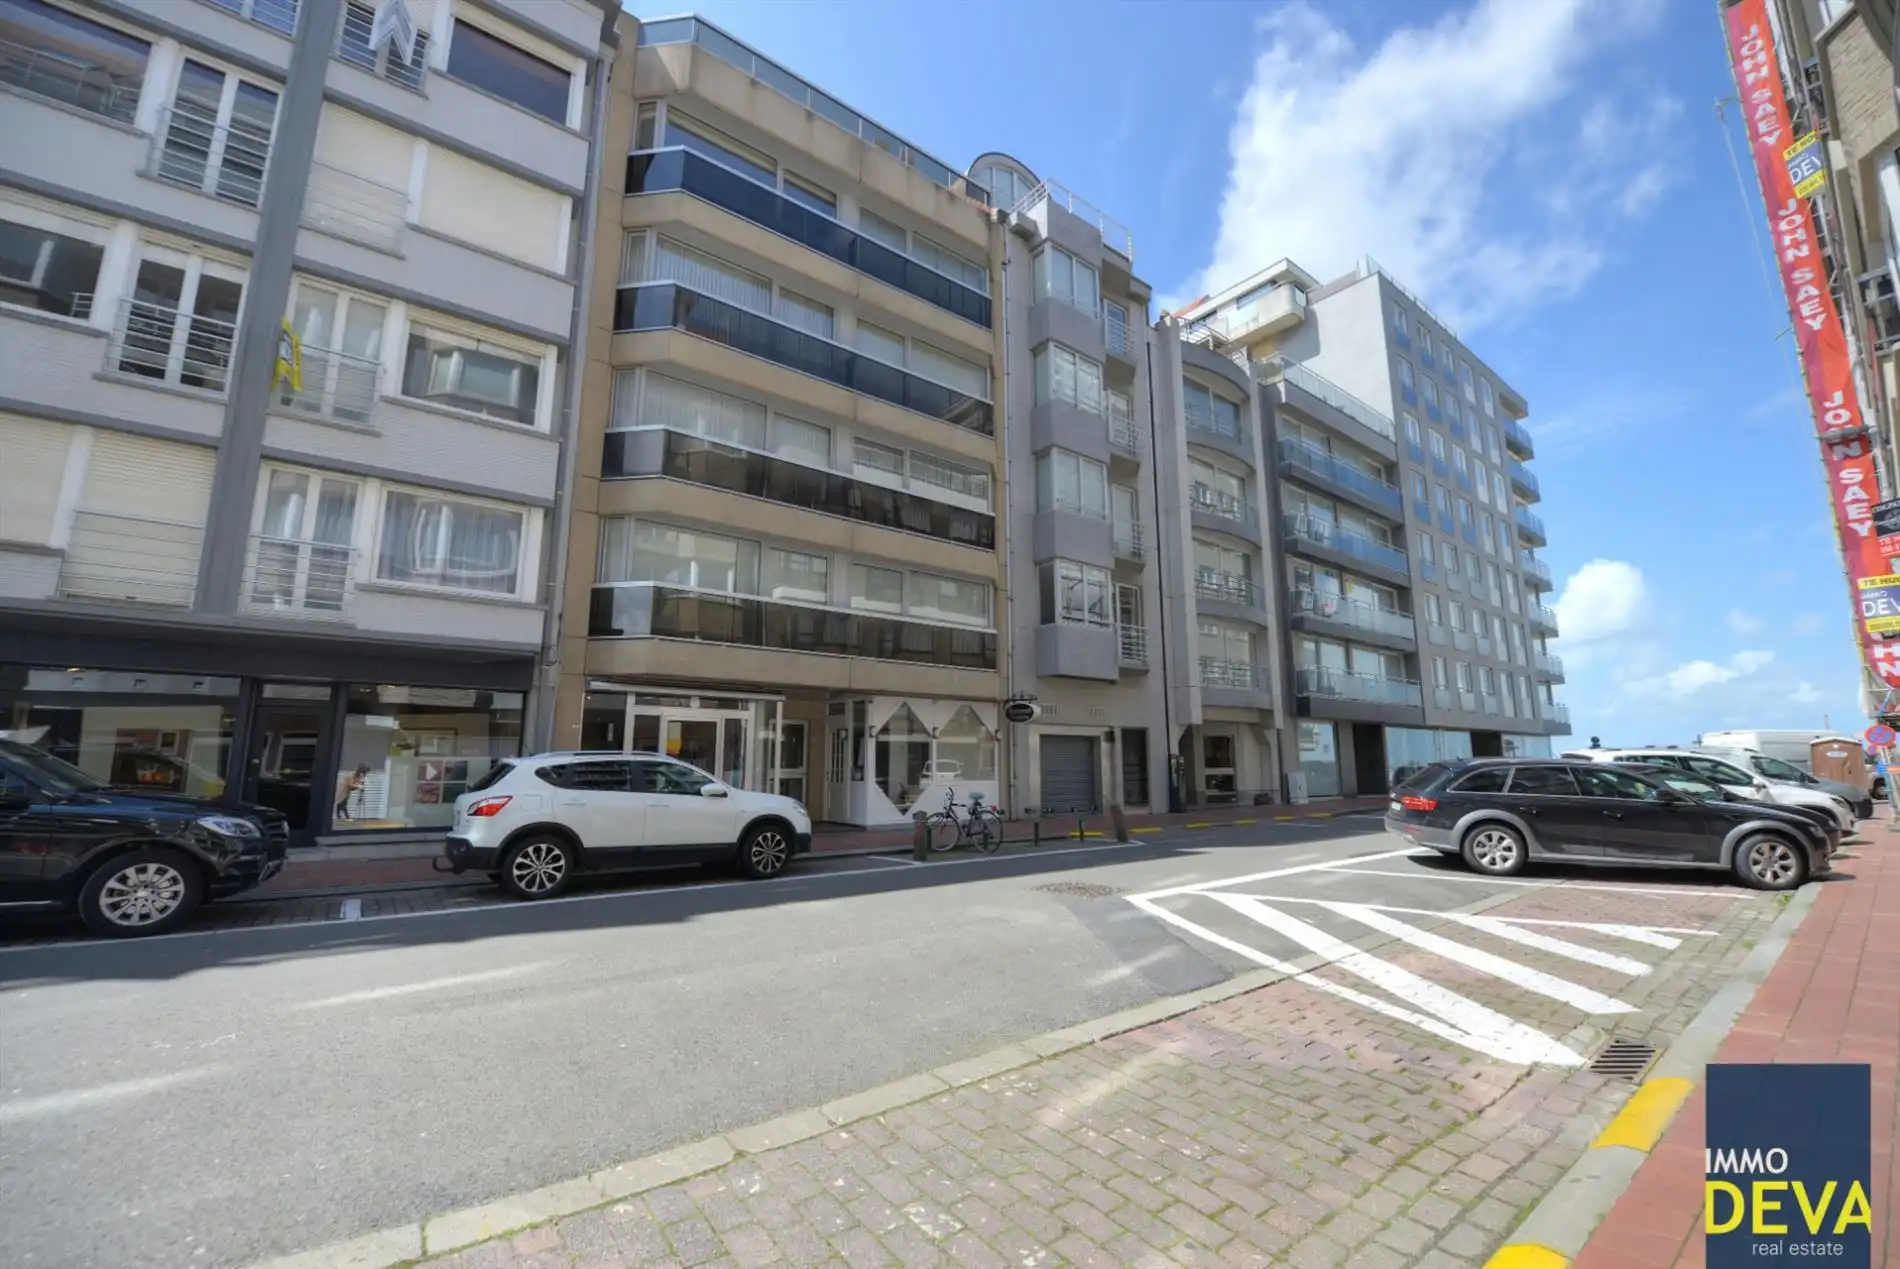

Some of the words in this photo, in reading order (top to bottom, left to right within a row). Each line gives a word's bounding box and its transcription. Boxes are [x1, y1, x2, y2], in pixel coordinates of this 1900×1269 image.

[1740, 24, 1769, 87] JOHN
[1751, 87, 1782, 146] SAEY
[1778, 199, 1810, 263] JOHN
[1790, 267, 1828, 331] SAEY
[1823, 390, 1863, 461] JON
[1839, 467, 1874, 537] SAEY
